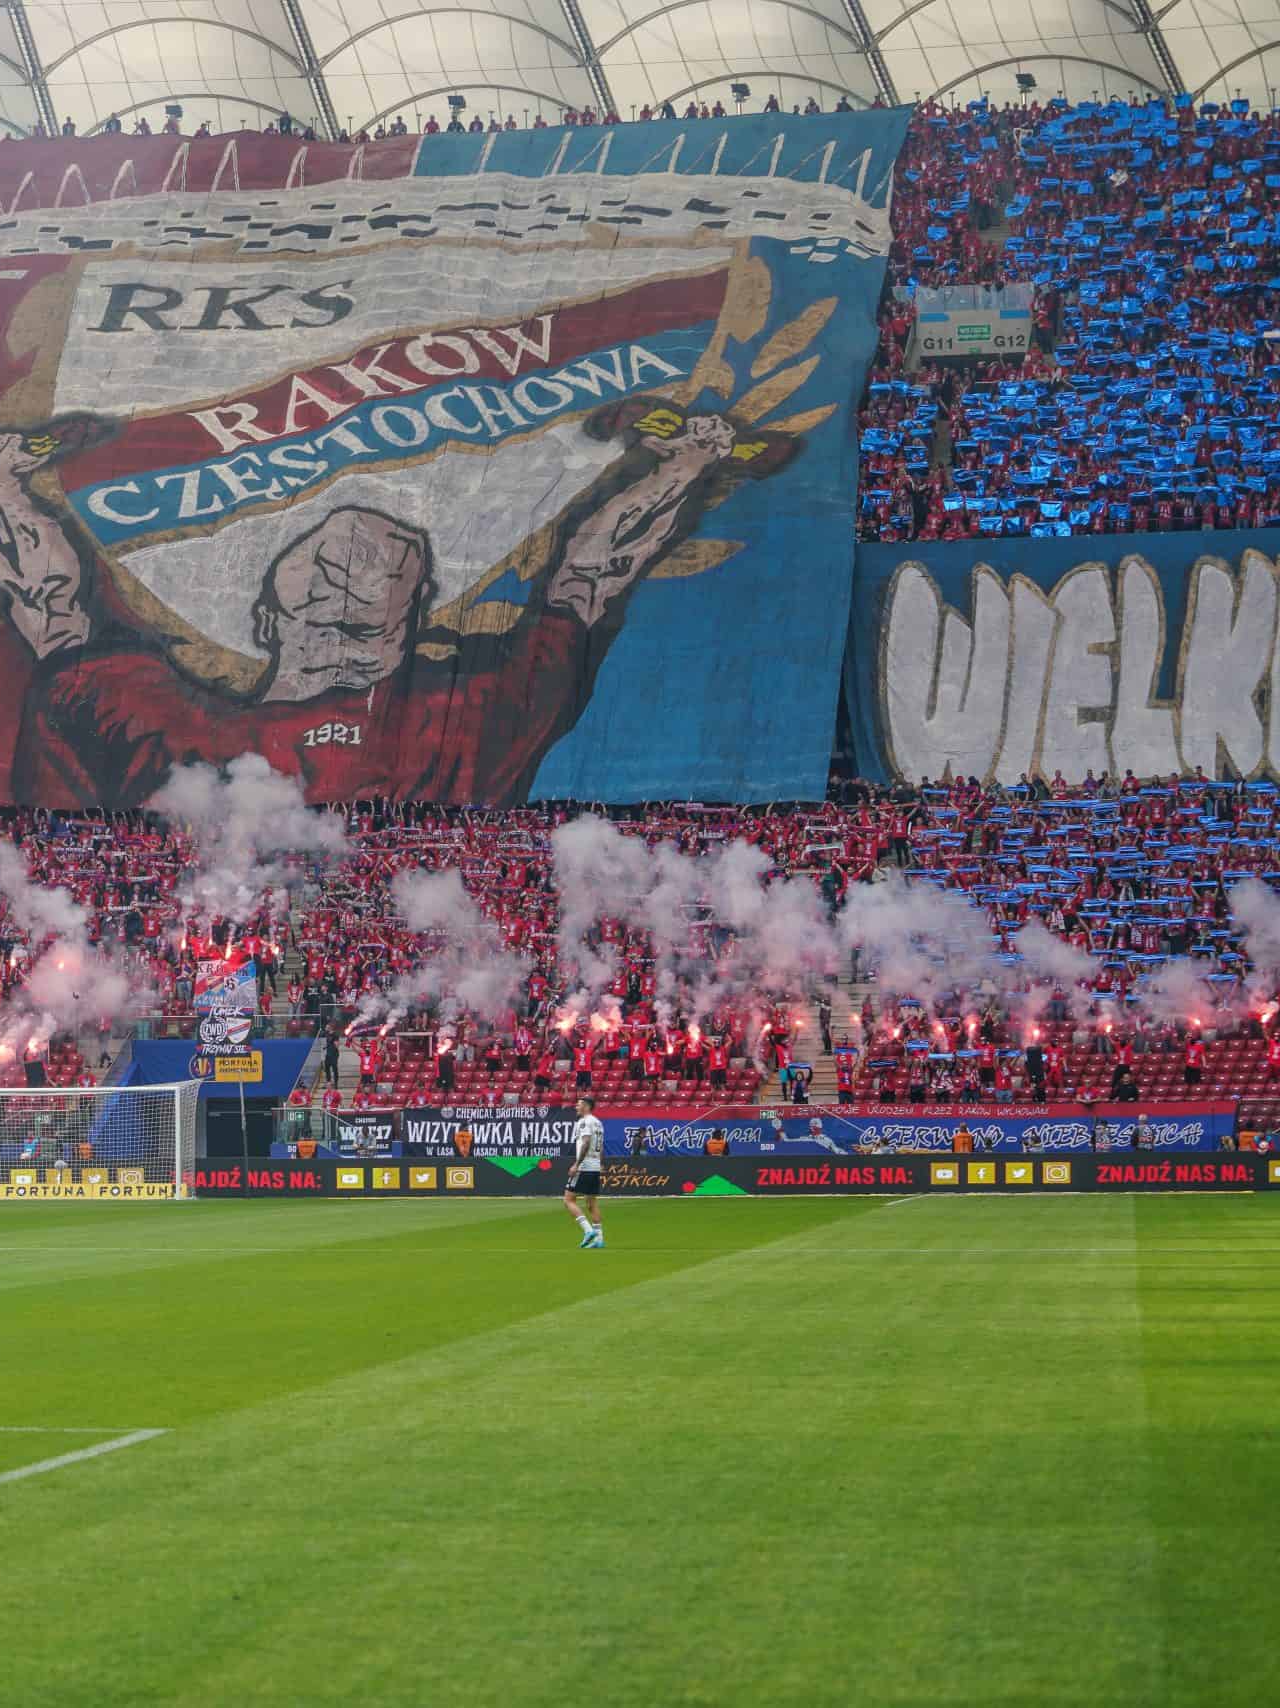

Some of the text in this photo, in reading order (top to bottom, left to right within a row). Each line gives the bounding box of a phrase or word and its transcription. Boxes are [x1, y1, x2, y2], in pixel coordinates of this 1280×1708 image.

[86, 280, 353, 332] RKS
[923, 337, 953, 350] G11
[993, 335, 1025, 348] G12
[86, 344, 688, 524] CZĘSTOCHOWA
[878, 547, 1280, 790] WIELK
[303, 722, 363, 747] 1921
[456, 1107, 535, 1120] CHEMICAL BROTHERS
[407, 1120, 514, 1145] WIZYTWKA
[859, 1123, 1004, 1150] CZERWNO
[247, 1171, 284, 1187] NAS
[289, 1171, 322, 1188] NA:
[600, 1175, 670, 1188] YSTKICH
[757, 1163, 913, 1185] ZNAJDŹ NAS NA:
[1096, 1161, 1255, 1184] ZNAJDŹ NAS NA:
[6, 1186, 85, 1197] FORTUNA
